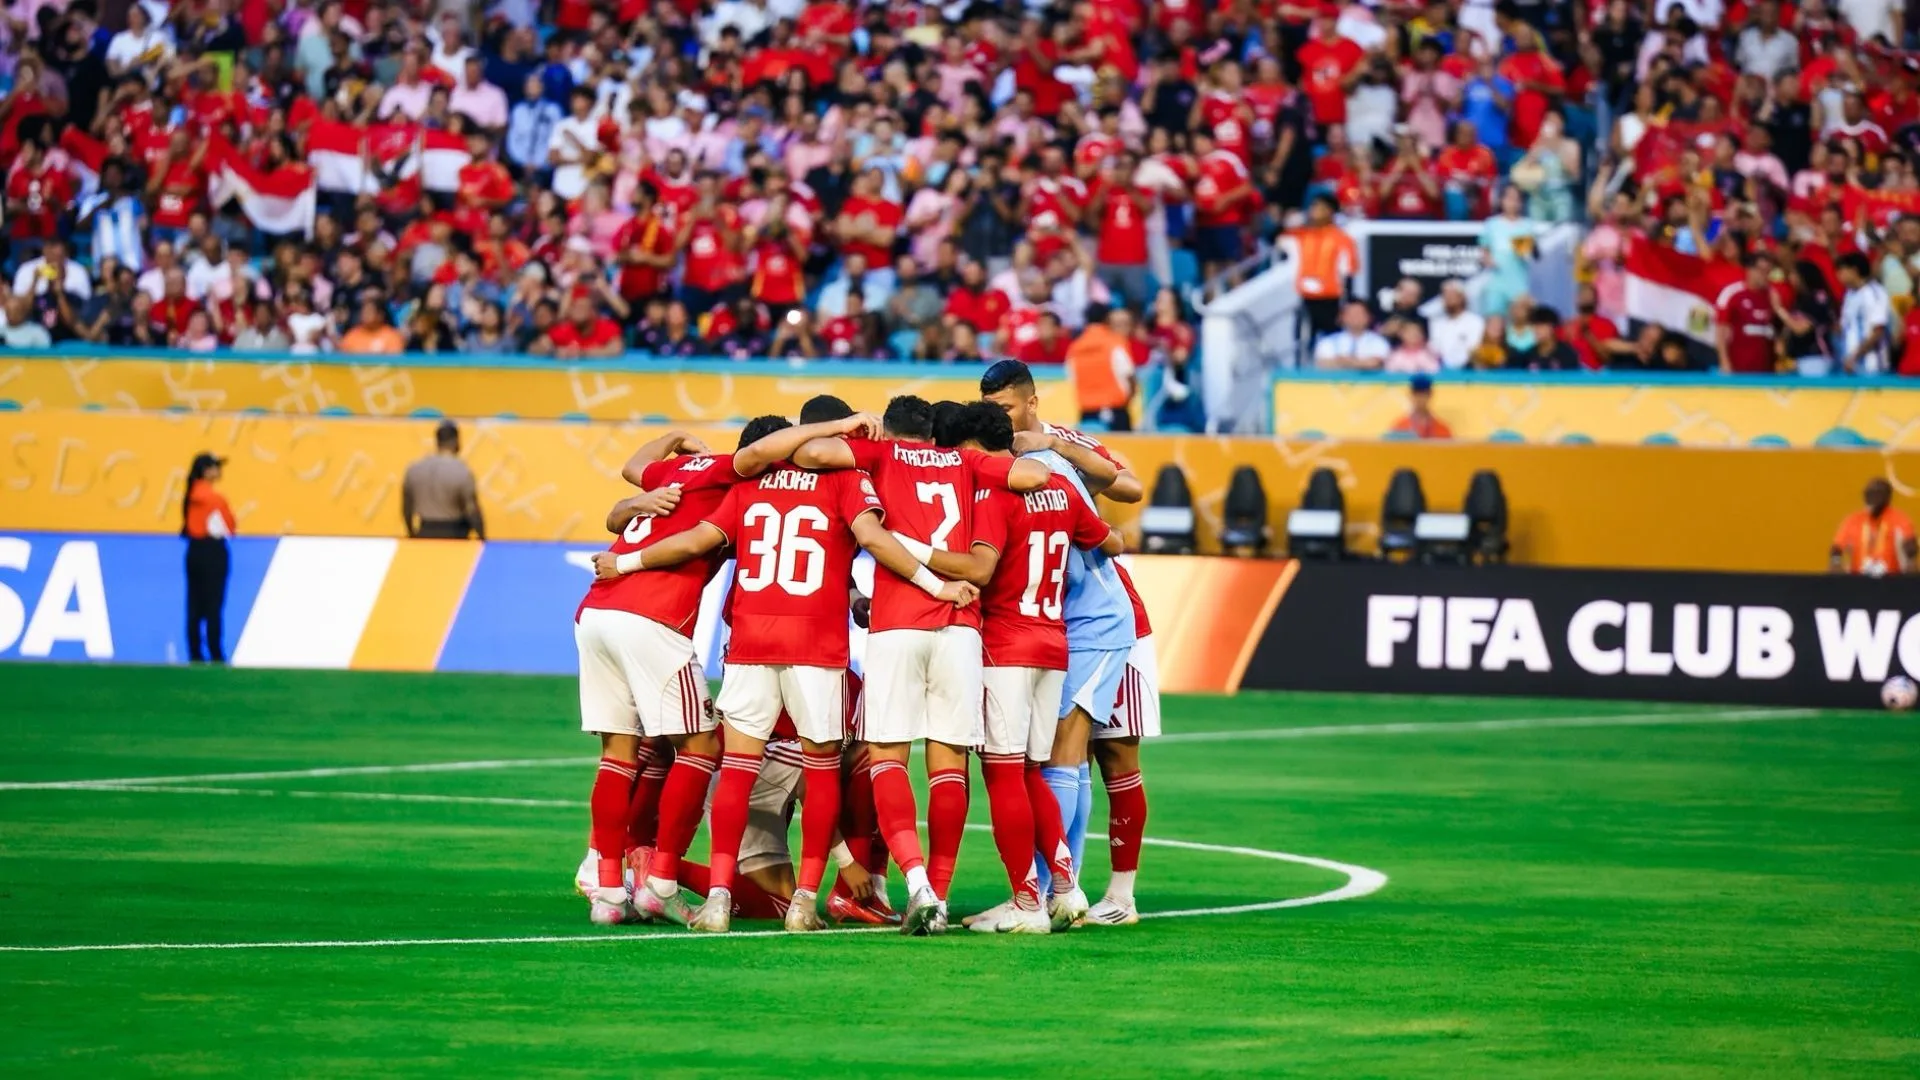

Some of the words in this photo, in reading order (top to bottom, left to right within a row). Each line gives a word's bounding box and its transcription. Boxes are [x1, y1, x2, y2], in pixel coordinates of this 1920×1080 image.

[759, 470, 818, 491] A.KOKA
[915, 481, 961, 553] 7
[738, 502, 829, 597] 36
[1018, 530, 1070, 621] 13
[1366, 594, 1552, 672] FIFA
[1567, 599, 1796, 679] CLUB
